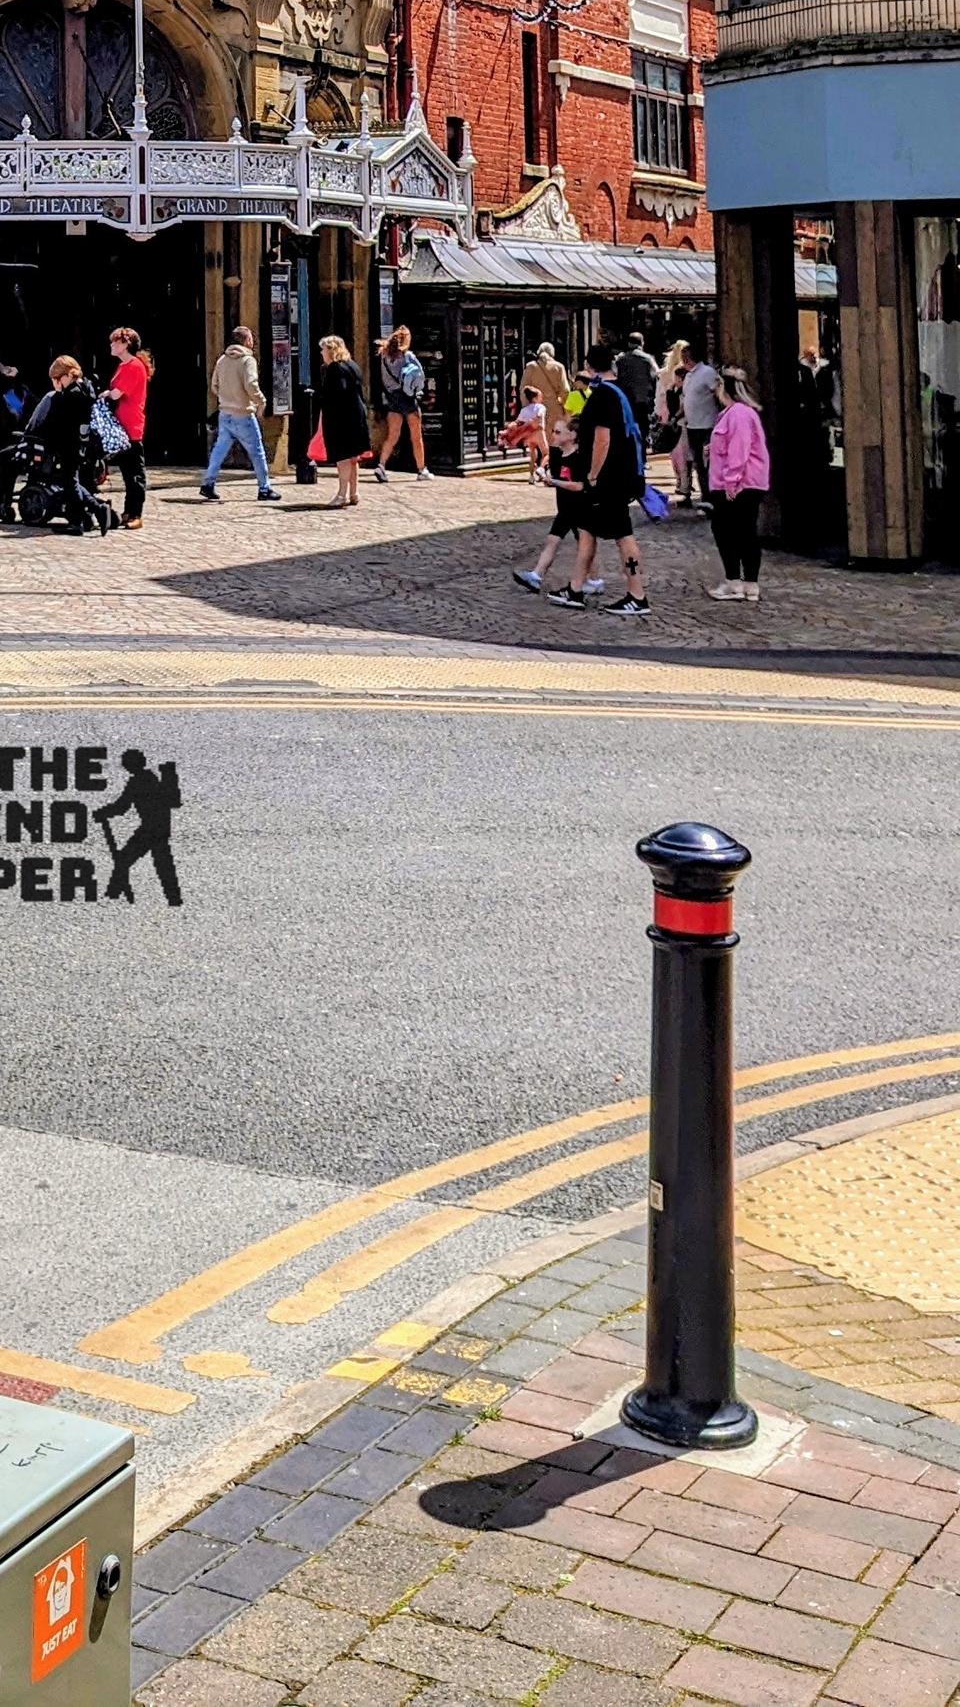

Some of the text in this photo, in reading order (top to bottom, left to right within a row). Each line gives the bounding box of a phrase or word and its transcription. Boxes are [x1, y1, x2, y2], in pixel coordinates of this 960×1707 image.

[27, 198, 104, 213] THEATRE
[177, 198, 285, 213] GRAND THEATRE
[41, 1617, 78, 1661] JUST EAT
